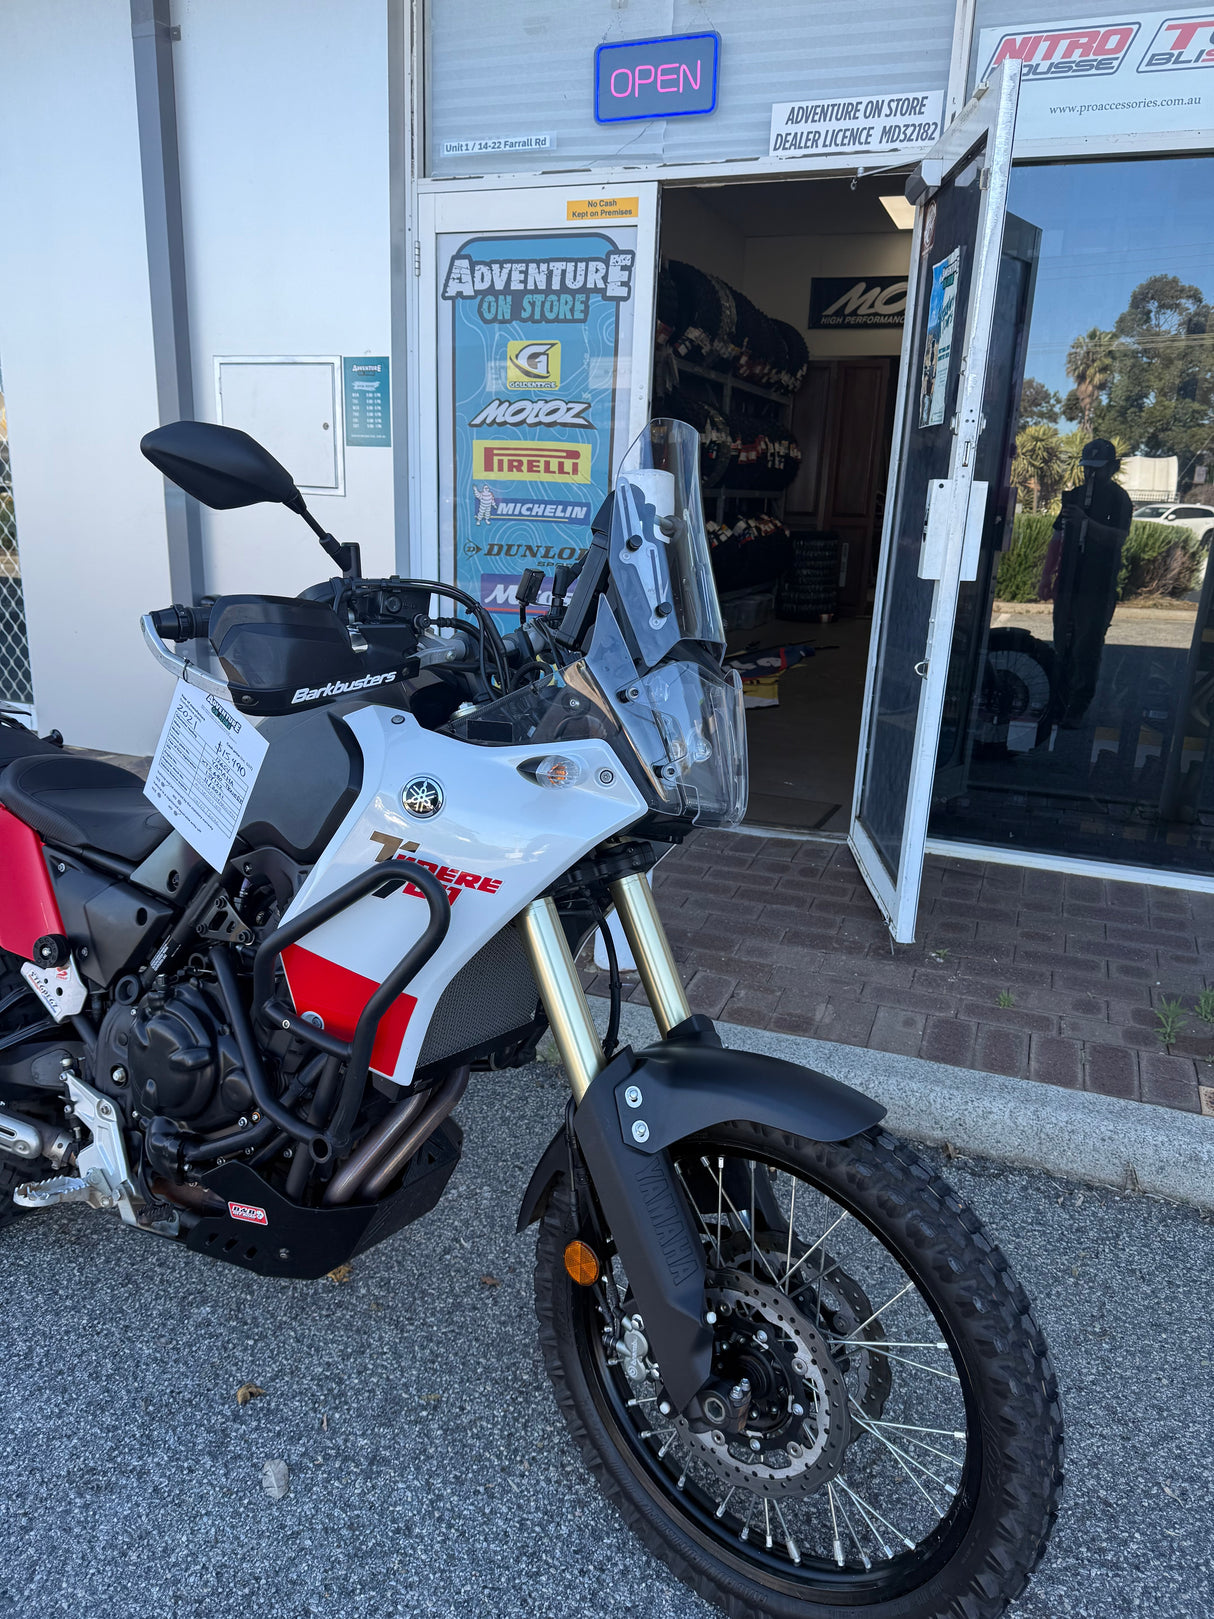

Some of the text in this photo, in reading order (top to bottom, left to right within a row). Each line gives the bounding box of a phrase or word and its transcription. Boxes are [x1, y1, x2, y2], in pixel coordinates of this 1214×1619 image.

[994, 27, 1133, 65] NITRO
[1165, 20, 1214, 50] T
[610, 59, 701, 98] OPEN
[786, 96, 928, 125] ADVENTURE ON STORE
[1049, 96, 1202, 116] www.proaccessories.com.au
[446, 143, 463, 152] Unit
[478, 141, 502, 150] 14-22
[504, 138, 532, 148] Farrall
[535, 137, 546, 146] Rd
[773, 122, 938, 151] DEALER LICENCE MD32182
[600, 208, 632, 217] Premises
[445, 254, 632, 297] ADVENTURE
[482, 294, 586, 320] ON STORE
[468, 399, 597, 430] MOTOZ
[484, 447, 581, 475] PIRELLI
[496, 502, 586, 518] MICHELIN
[291, 671, 397, 704] Barkbusters
[177, 704, 197, 730] 2021
[206, 694, 241, 734] ADVENTURE
[635, 1156, 699, 1286] YAMAHA
